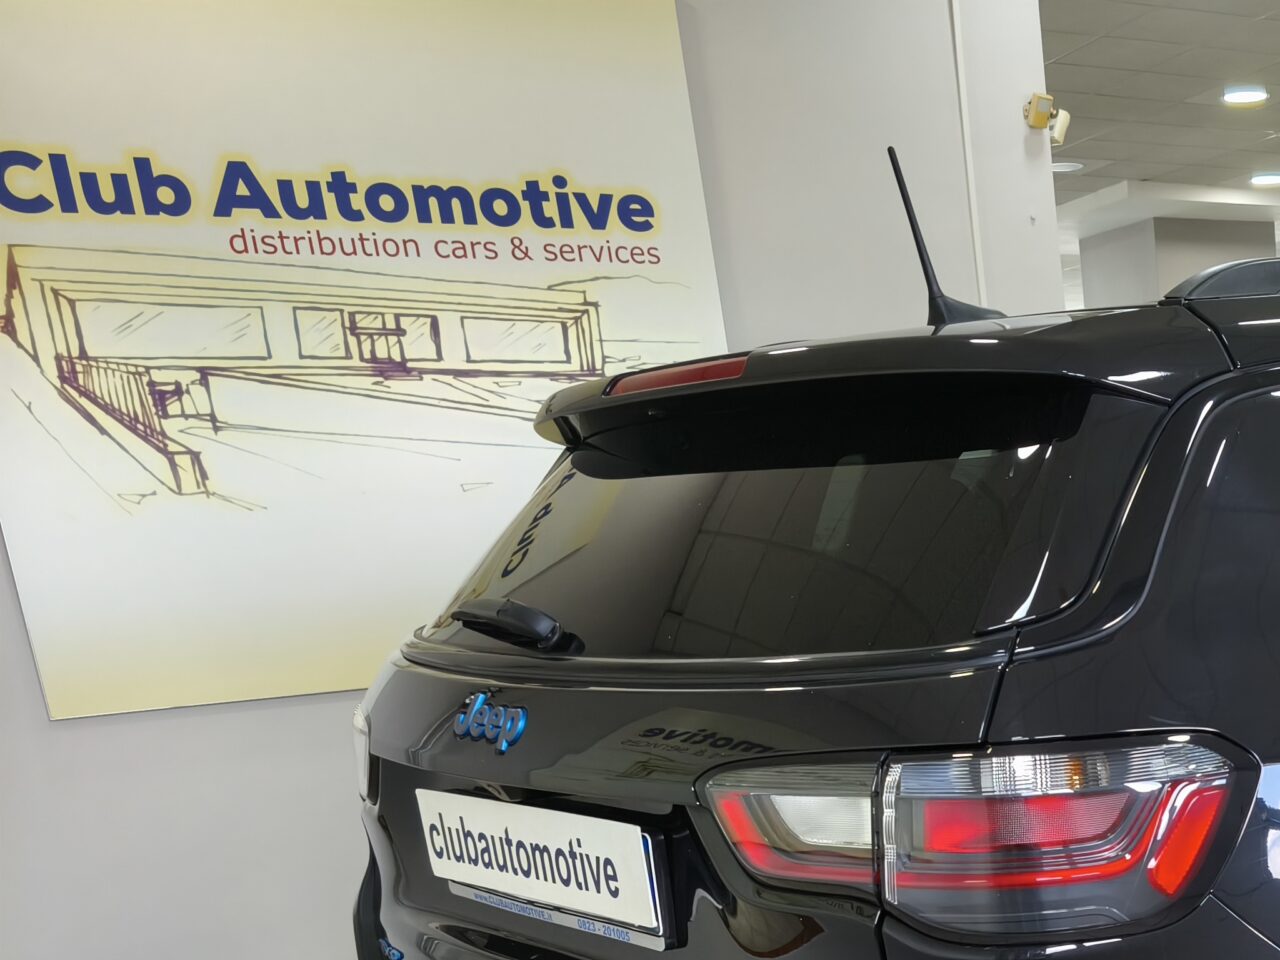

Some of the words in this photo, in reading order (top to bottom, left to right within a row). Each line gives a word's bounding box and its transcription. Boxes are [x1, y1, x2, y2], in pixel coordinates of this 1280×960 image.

[0, 150, 192, 217] Club
[212, 160, 655, 232] Automotive
[229, 228, 420, 258] distribution
[433, 237, 499, 261] cars
[510, 236, 534, 261] &
[543, 239, 661, 265] services
[453, 691, 529, 756] Jeep
[429, 812, 620, 899] clubautomotive
[577, 919, 596, 932] 0823
[602, 926, 631, 942] 201005
